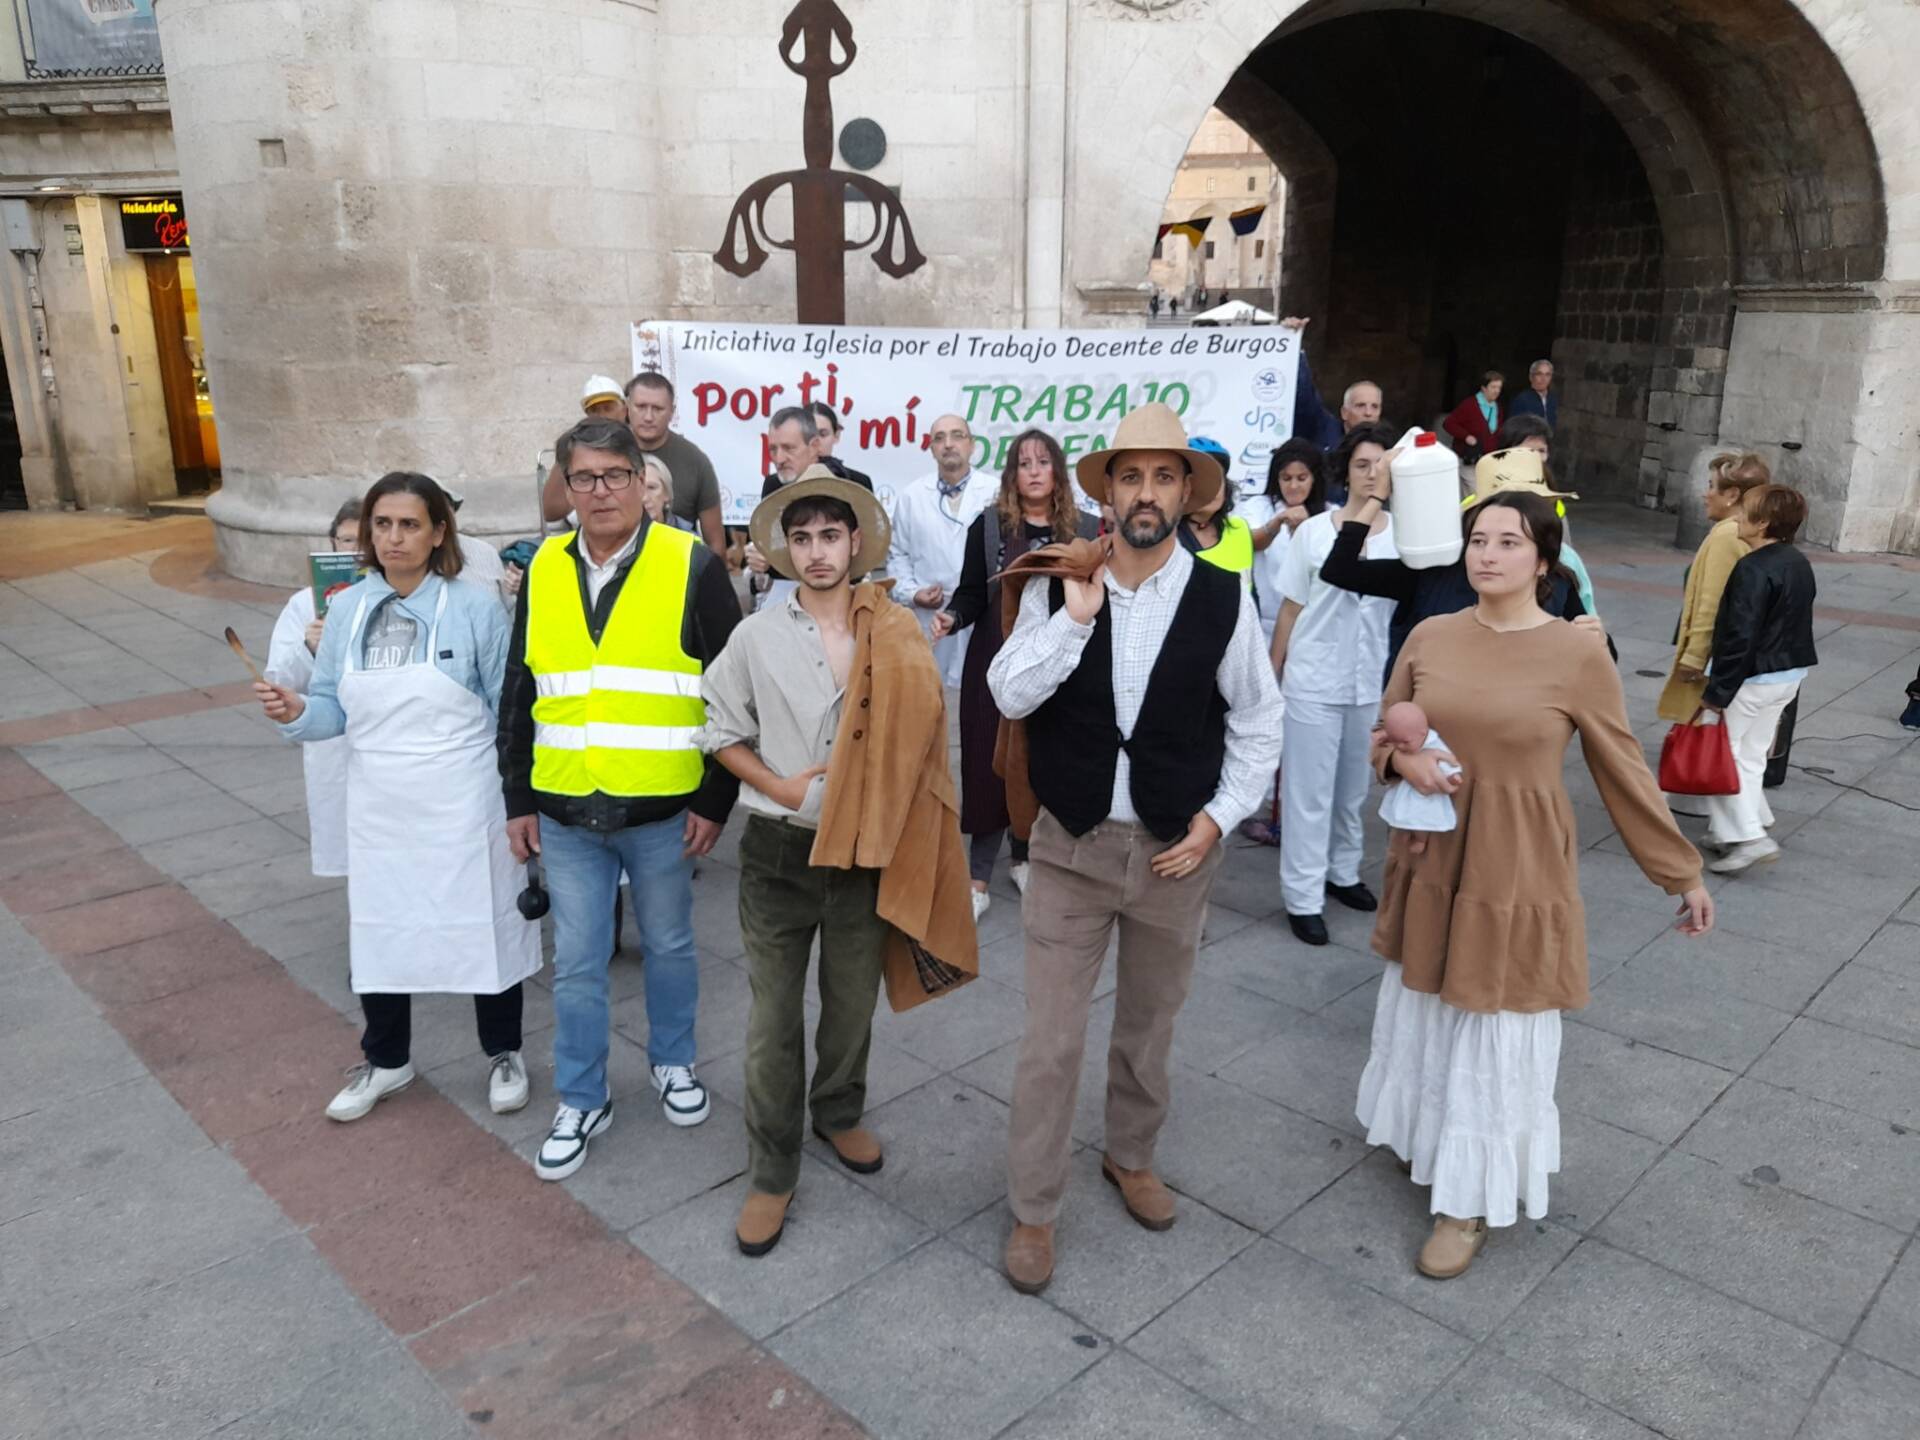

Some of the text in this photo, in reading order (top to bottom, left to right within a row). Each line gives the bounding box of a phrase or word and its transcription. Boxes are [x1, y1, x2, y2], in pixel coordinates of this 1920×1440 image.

[682, 330, 796, 353] Iniciativa
[802, 329, 883, 359] Iglesia
[889, 339, 930, 360] por
[937, 333, 960, 356] el
[967, 335, 1057, 363] Trabajo
[1065, 336, 1164, 358] Decente
[1171, 332, 1200, 356] de
[1206, 333, 1290, 358] Burgos
[692, 363, 854, 427] por ti,
[859, 396, 932, 450] mí,
